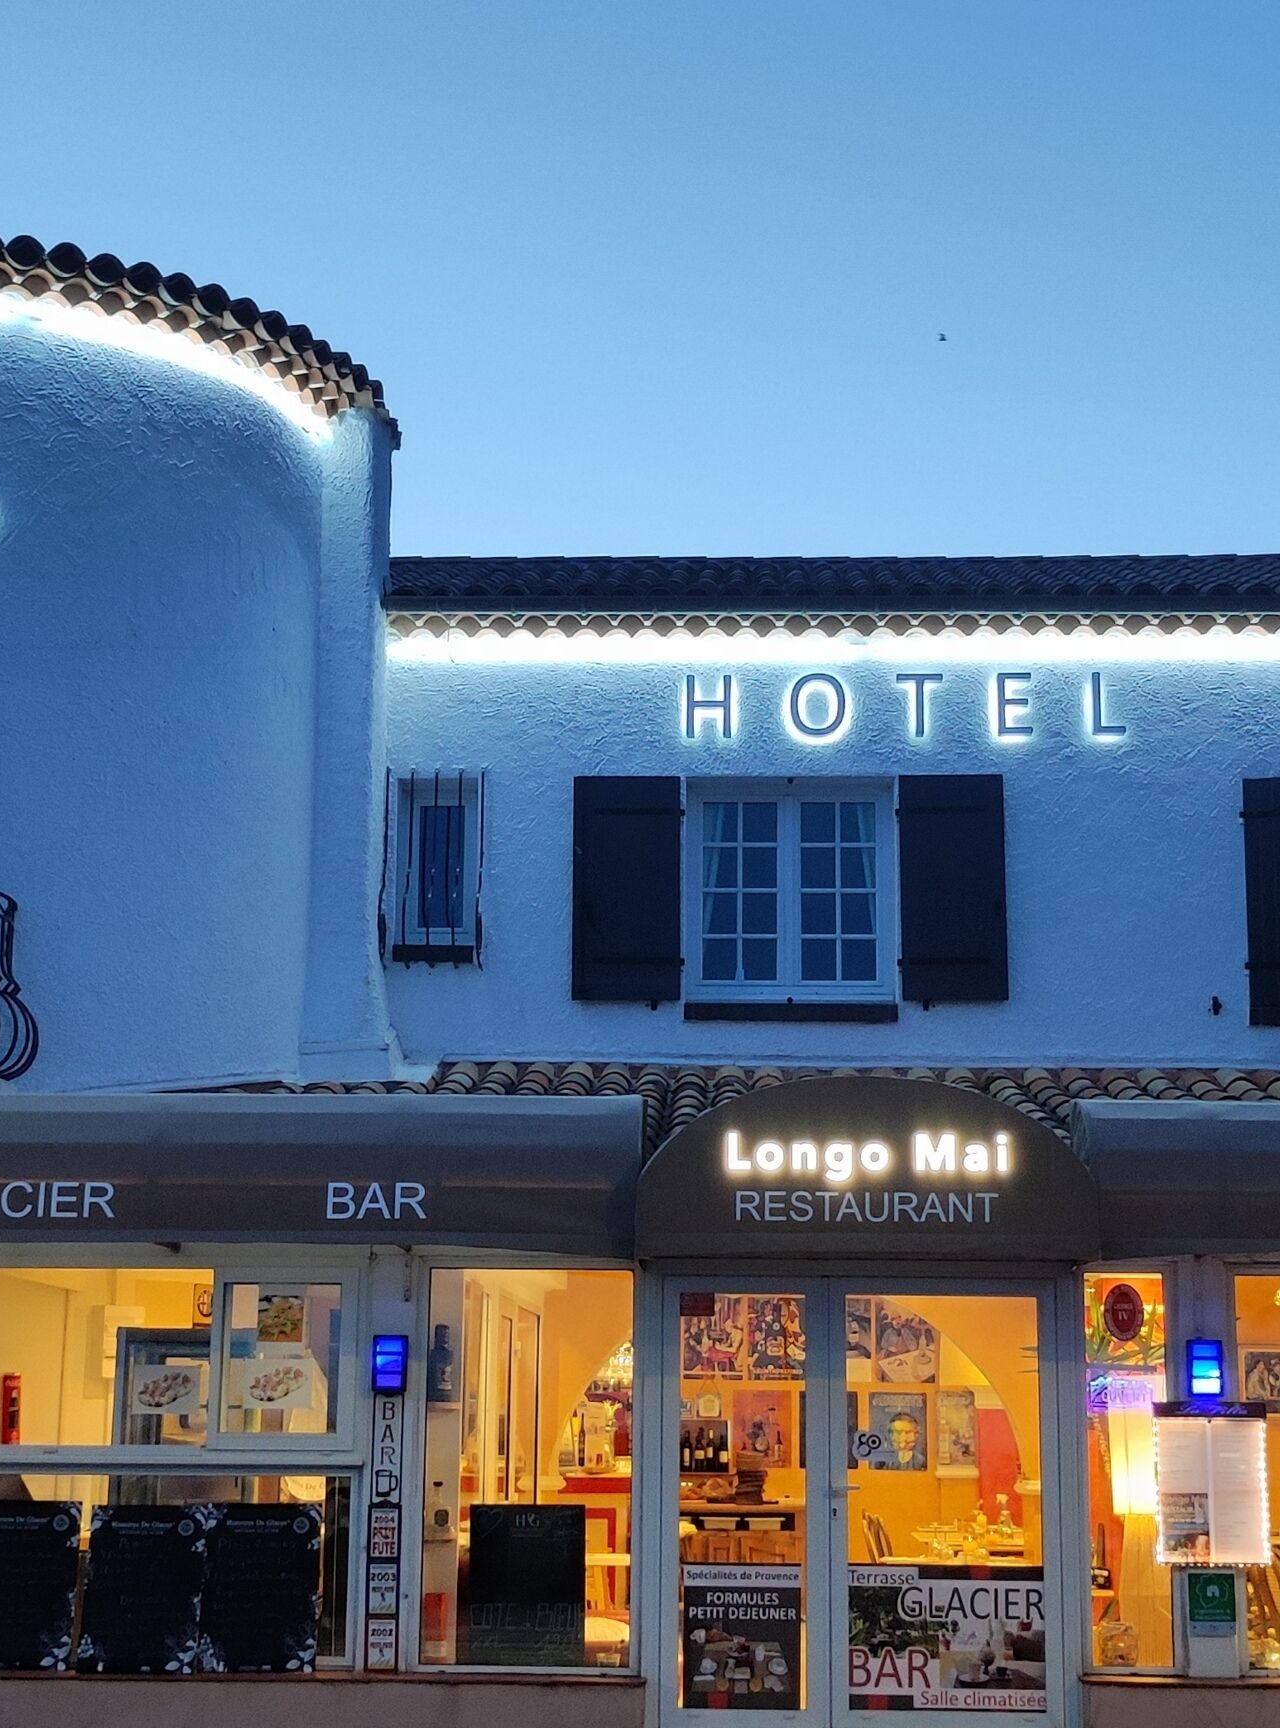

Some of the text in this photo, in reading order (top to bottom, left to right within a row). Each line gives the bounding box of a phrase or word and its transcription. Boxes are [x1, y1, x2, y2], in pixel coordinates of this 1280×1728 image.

[685, 672, 1127, 738] HOTEL
[726, 1131, 1010, 1182] Longo Mai
[326, 1182, 427, 1219] BAR
[734, 1190, 999, 1223] RESTAURANT
[380, 1401, 397, 1465] BAR
[374, 1515, 396, 1524] 2004
[371, 1572, 396, 1582] 2003
[686, 1570, 799, 1581] Spécialités de Provence
[849, 1569, 915, 1586] Terrasse
[706, 1591, 780, 1605] FORMULES
[900, 1586, 1045, 1620] GLACIER
[688, 1606, 797, 1620] PETIT DEJEUNER
[370, 1628, 393, 1637] 2002
[848, 1649, 931, 1689] BAR
[920, 1690, 1046, 1708] Salle climatisée
